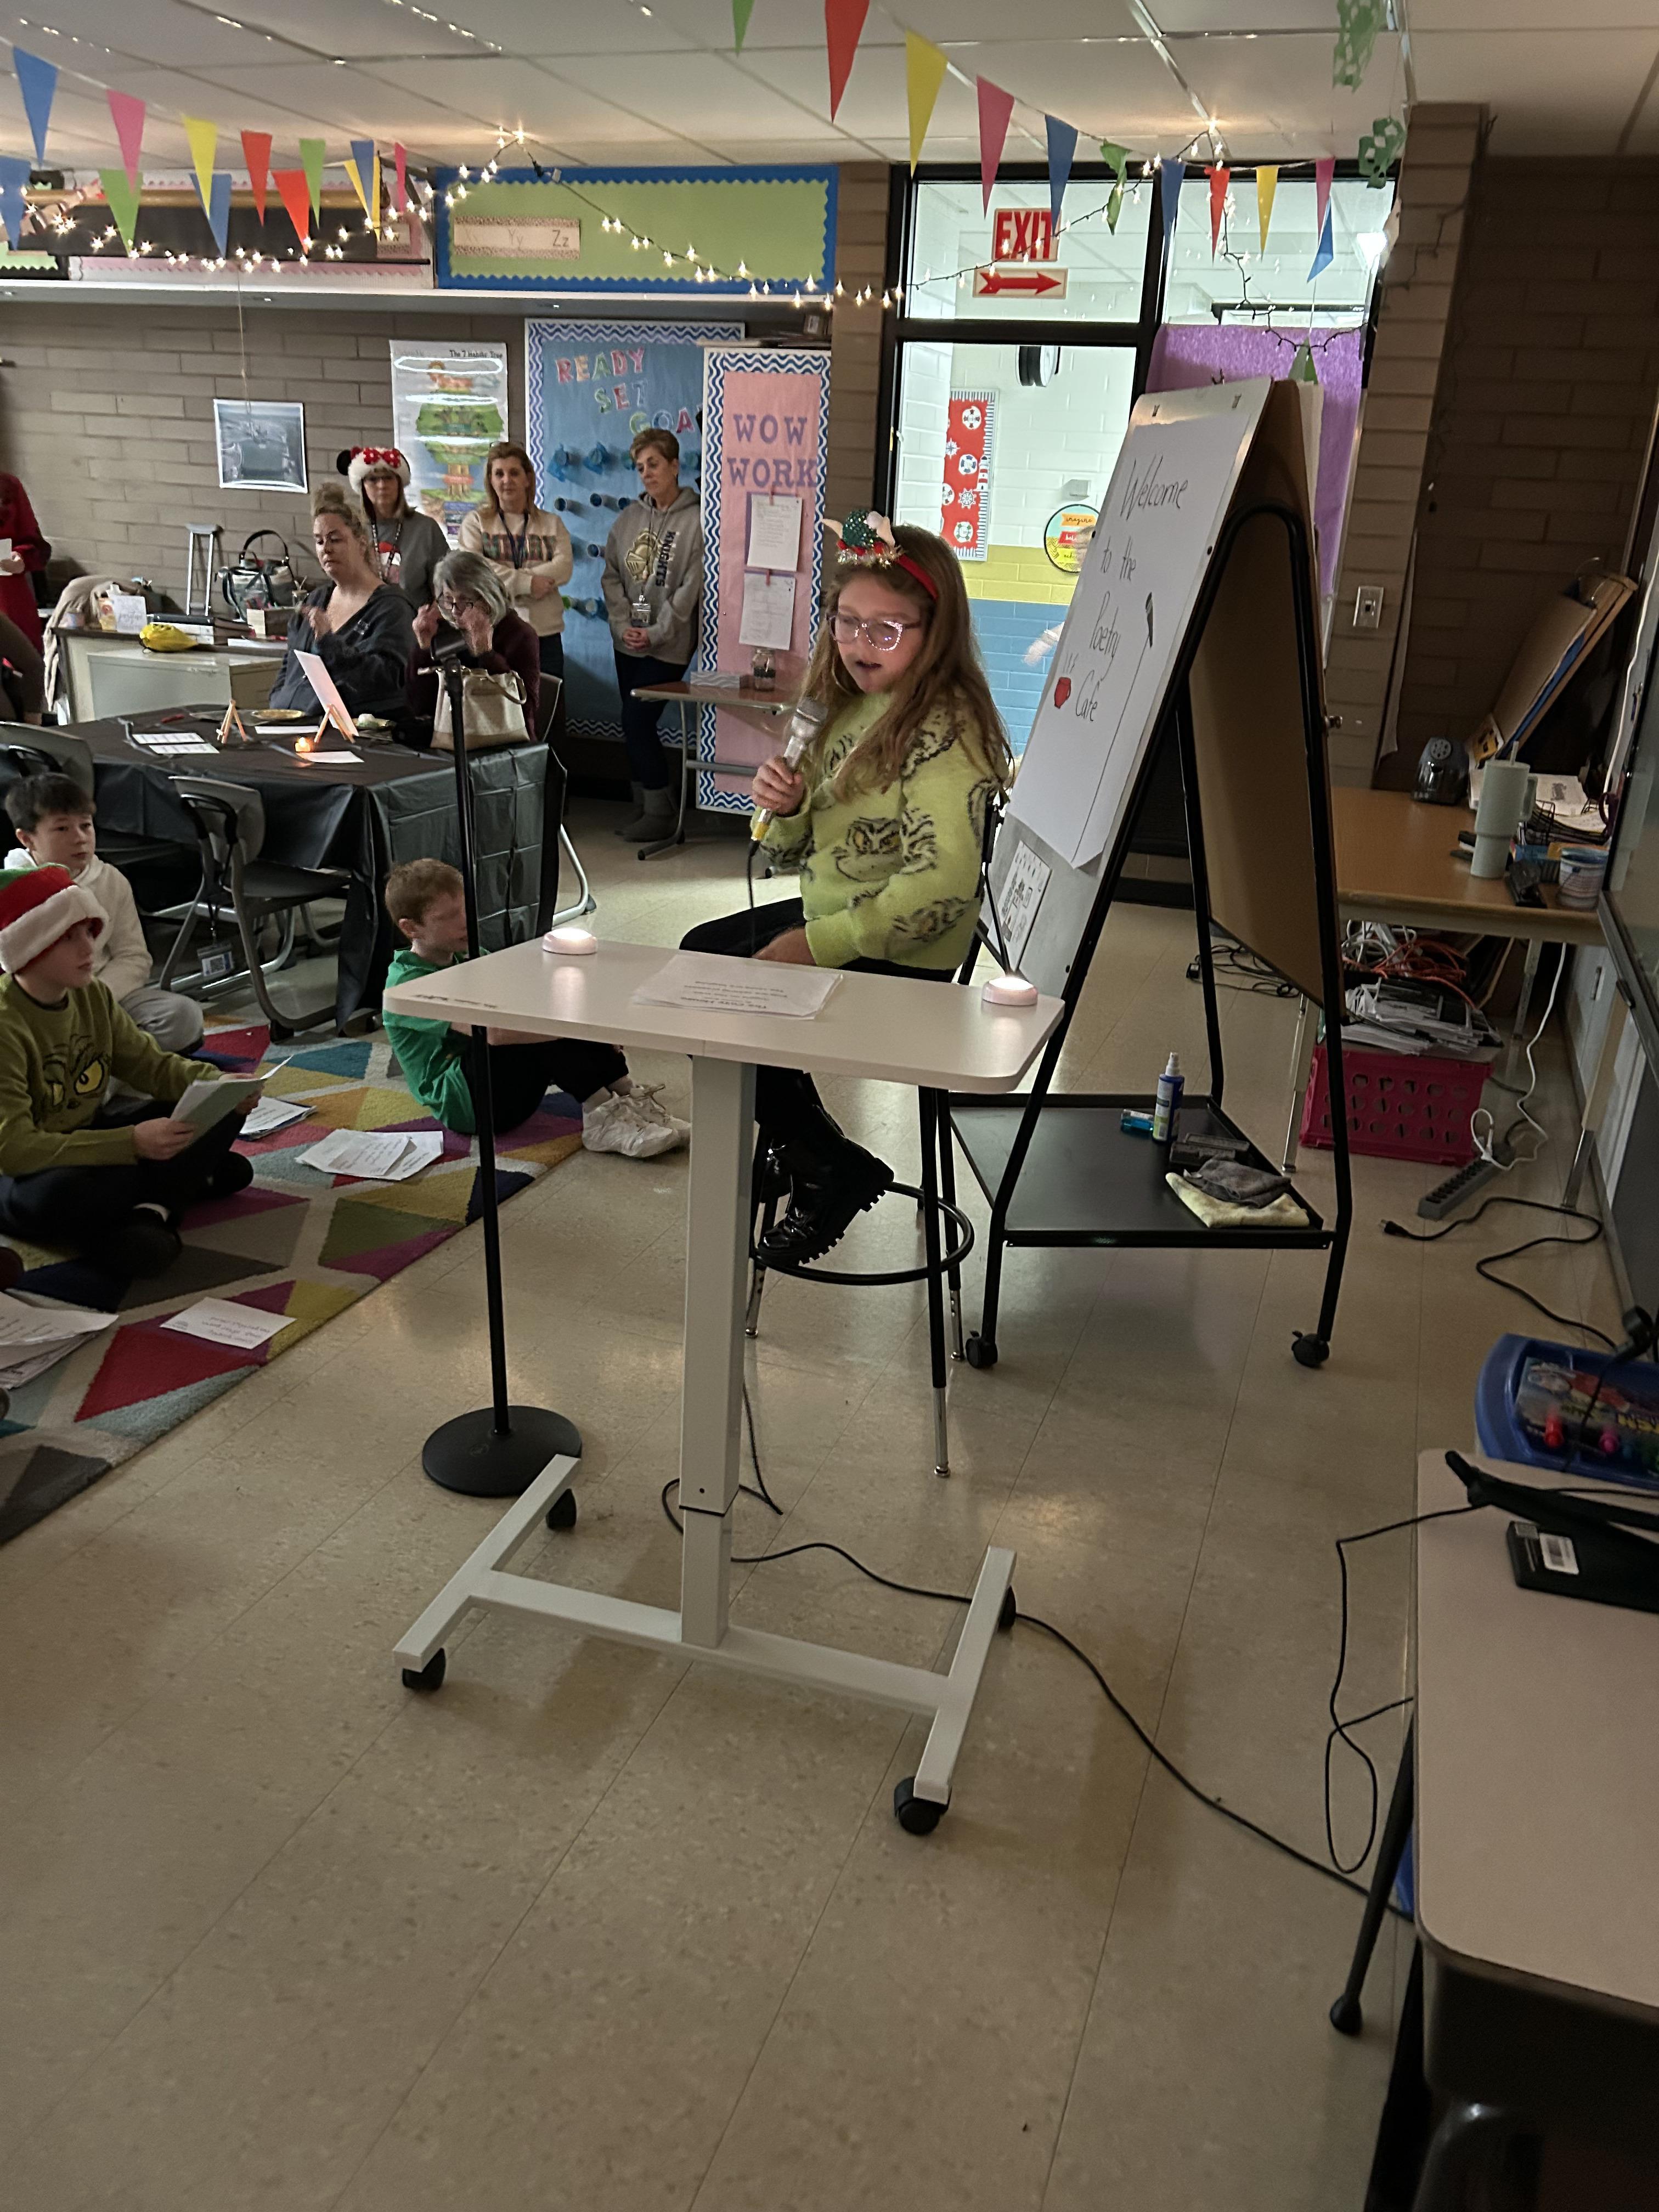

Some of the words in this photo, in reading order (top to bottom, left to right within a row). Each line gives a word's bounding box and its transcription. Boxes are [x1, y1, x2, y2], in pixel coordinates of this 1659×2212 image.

[552, 229, 569, 247] Zz
[995, 211, 1053, 259] EXIT
[555, 346, 645, 383] READY
[594, 379, 649, 413] SET
[629, 404, 703, 435] GOA
[733, 414, 808, 446] WOW
[727, 457, 817, 488] WORK
[1120, 452, 1189, 521] Welcome
[1066, 517, 1093, 526] imagine
[655, 531, 676, 587] KNIGHTS
[1101, 535, 1113, 574] to
[1119, 535, 1137, 582] the
[1089, 590, 1121, 682] Poetry
[1075, 669, 1100, 722] Cafe
